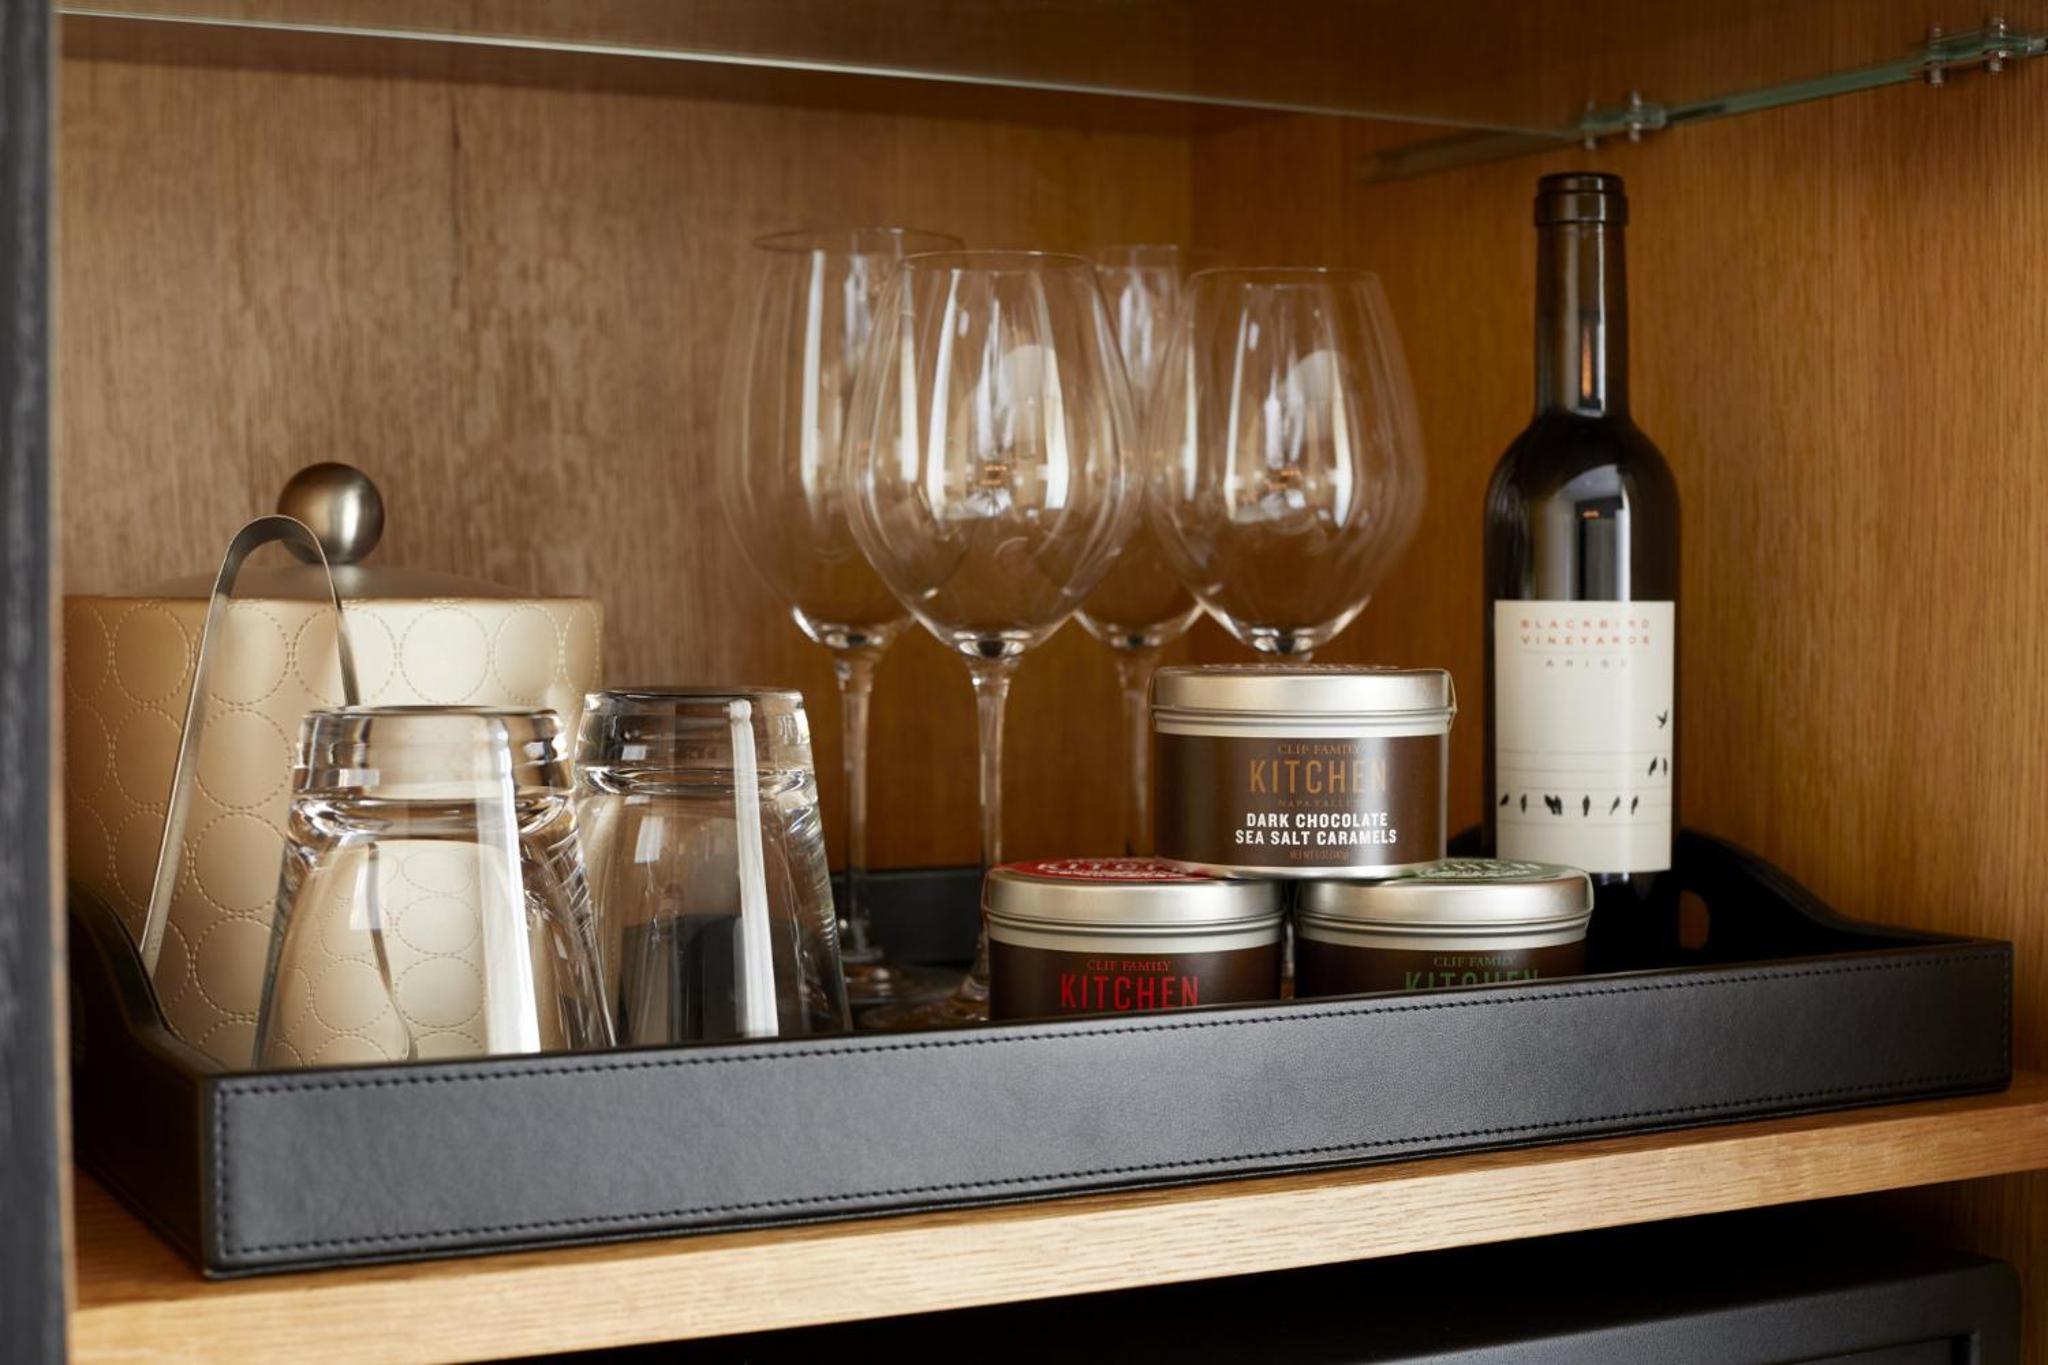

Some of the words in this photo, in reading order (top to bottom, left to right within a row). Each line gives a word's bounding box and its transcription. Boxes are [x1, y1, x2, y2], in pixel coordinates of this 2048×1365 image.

[1520, 618, 1650, 629] BLACKBIRD
[1520, 635, 1650, 645] VINEYARDS
[1250, 758, 1388, 793] KITCHEN
[1246, 812, 1290, 829] DARK
[1295, 812, 1388, 829] CHOCOLATE
[1235, 829, 1265, 845] SEA
[1270, 830, 1310, 846] SALT
[1316, 829, 1398, 846] CARAMELS
[1087, 960, 1118, 971] CLIF
[1121, 960, 1172, 972] FAMILY
[1434, 956, 1465, 967] CLIF
[1060, 974, 1200, 1011] KITCHEN
